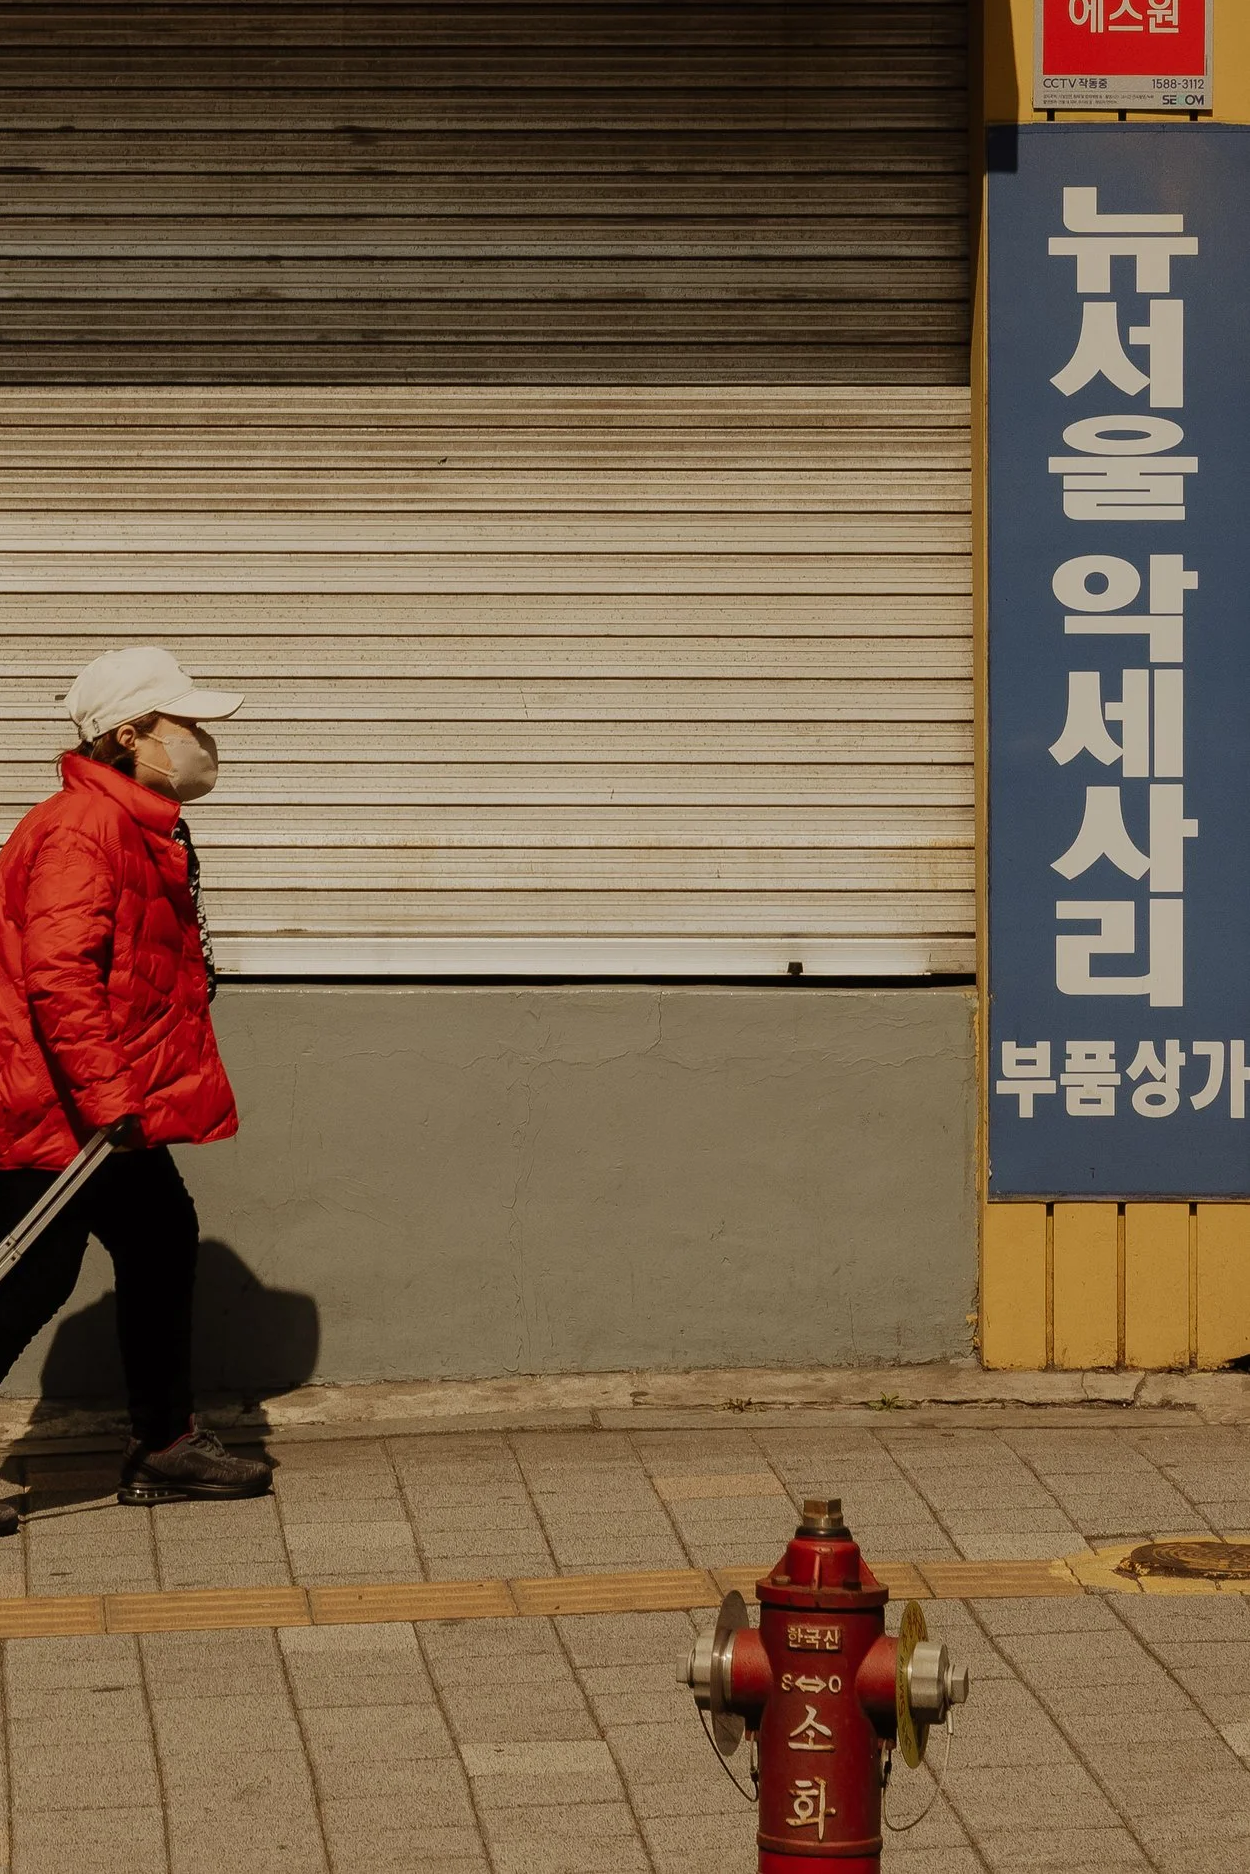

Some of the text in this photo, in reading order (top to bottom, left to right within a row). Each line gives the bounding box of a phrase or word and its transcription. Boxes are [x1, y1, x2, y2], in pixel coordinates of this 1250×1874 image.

[1042, 78, 1108, 89] CCTV 작동중
[1152, 78, 1205, 90] 1588-3112
[1162, 94, 1205, 106] SEOM
[1048, 186, 1199, 521] 뉴서울
[1047, 553, 1199, 1008] 악세사리
[996, 1039, 1250, 1119] 부품상가
[787, 1626, 839, 1650] 한국산
[781, 1674, 793, 1692] S
[786, 1704, 837, 1841] 소화
